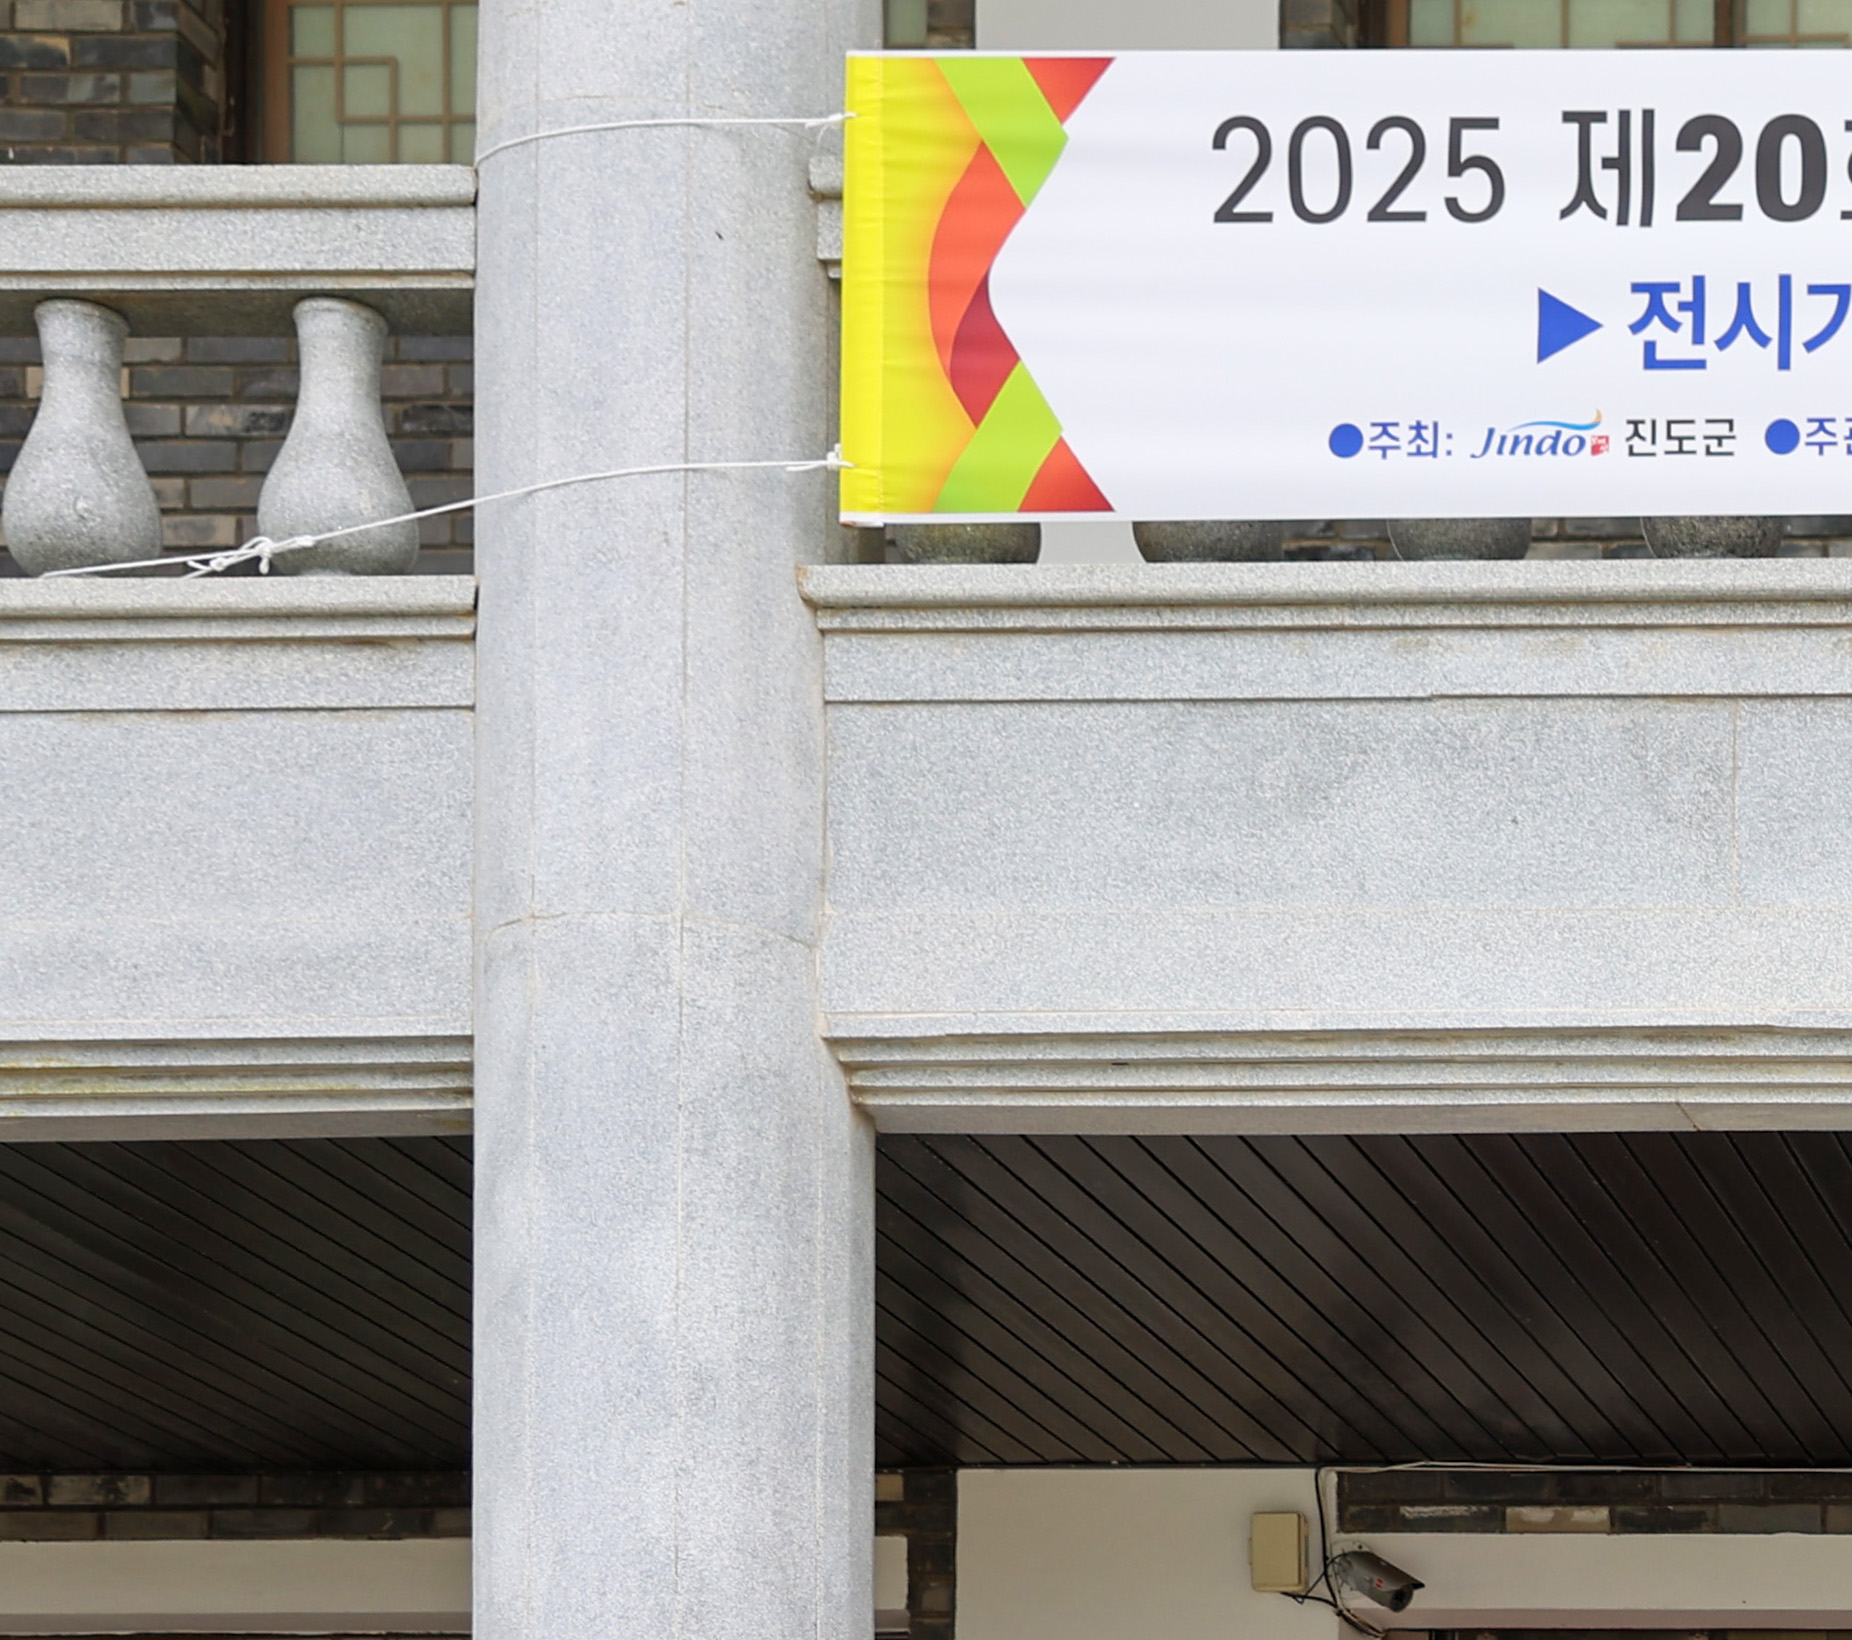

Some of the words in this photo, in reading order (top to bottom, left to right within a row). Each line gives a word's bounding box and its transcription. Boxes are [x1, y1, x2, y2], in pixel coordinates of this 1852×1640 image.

[1212, 116, 1505, 225] 2025
[1368, 419, 1453, 460] 주최:
[1470, 426, 1587, 459] Jindo
[1626, 418, 1737, 457] 진도군
